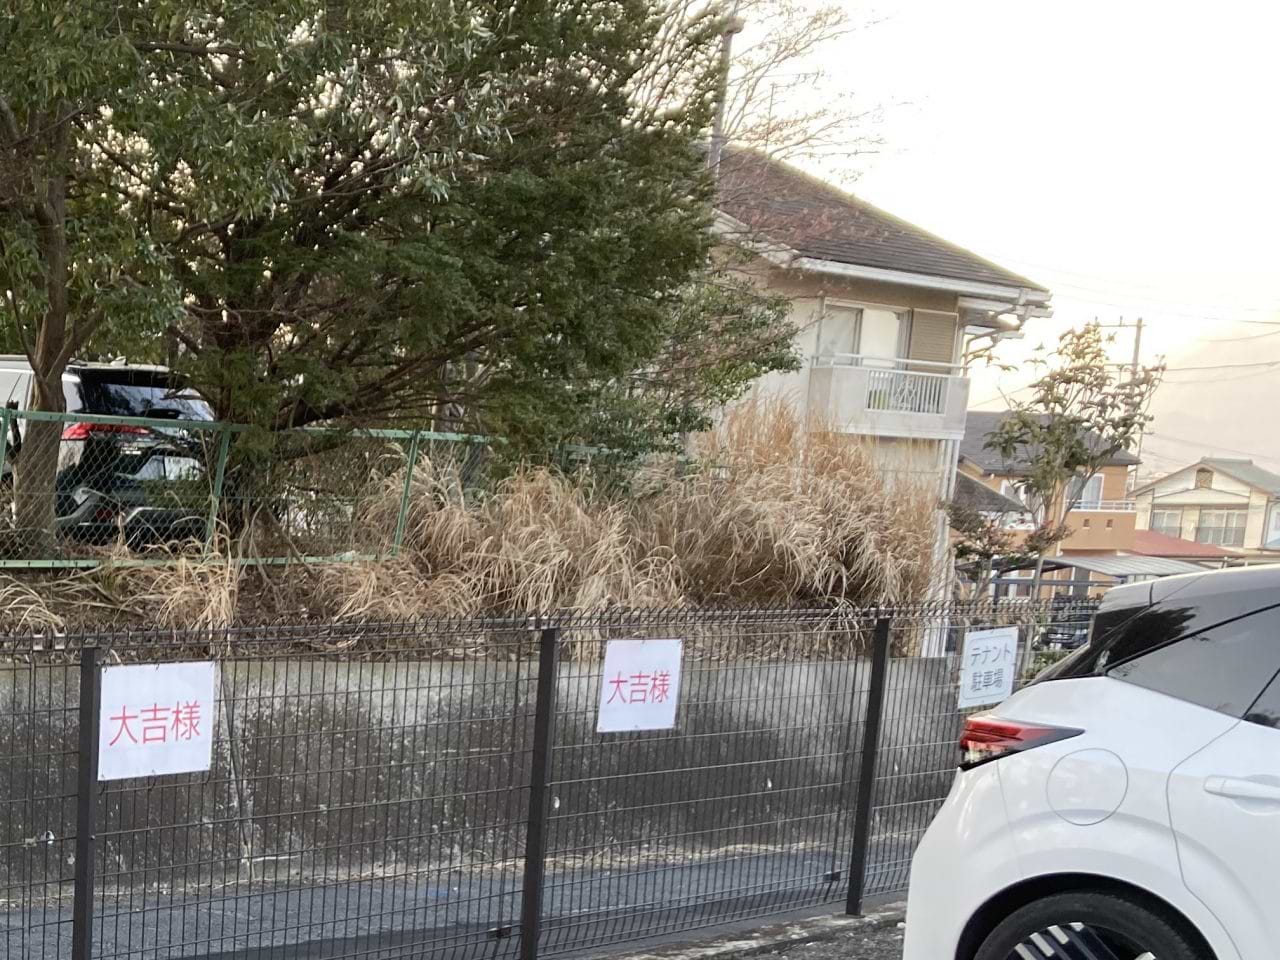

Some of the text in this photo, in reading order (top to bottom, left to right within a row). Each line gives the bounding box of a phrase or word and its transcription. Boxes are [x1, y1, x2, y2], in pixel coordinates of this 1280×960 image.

[970, 642, 1011, 666] テナント
[607, 670, 671, 704] 大吉様
[970, 668, 1004, 692] 駐車場
[108, 700, 201, 746] 大吉様
